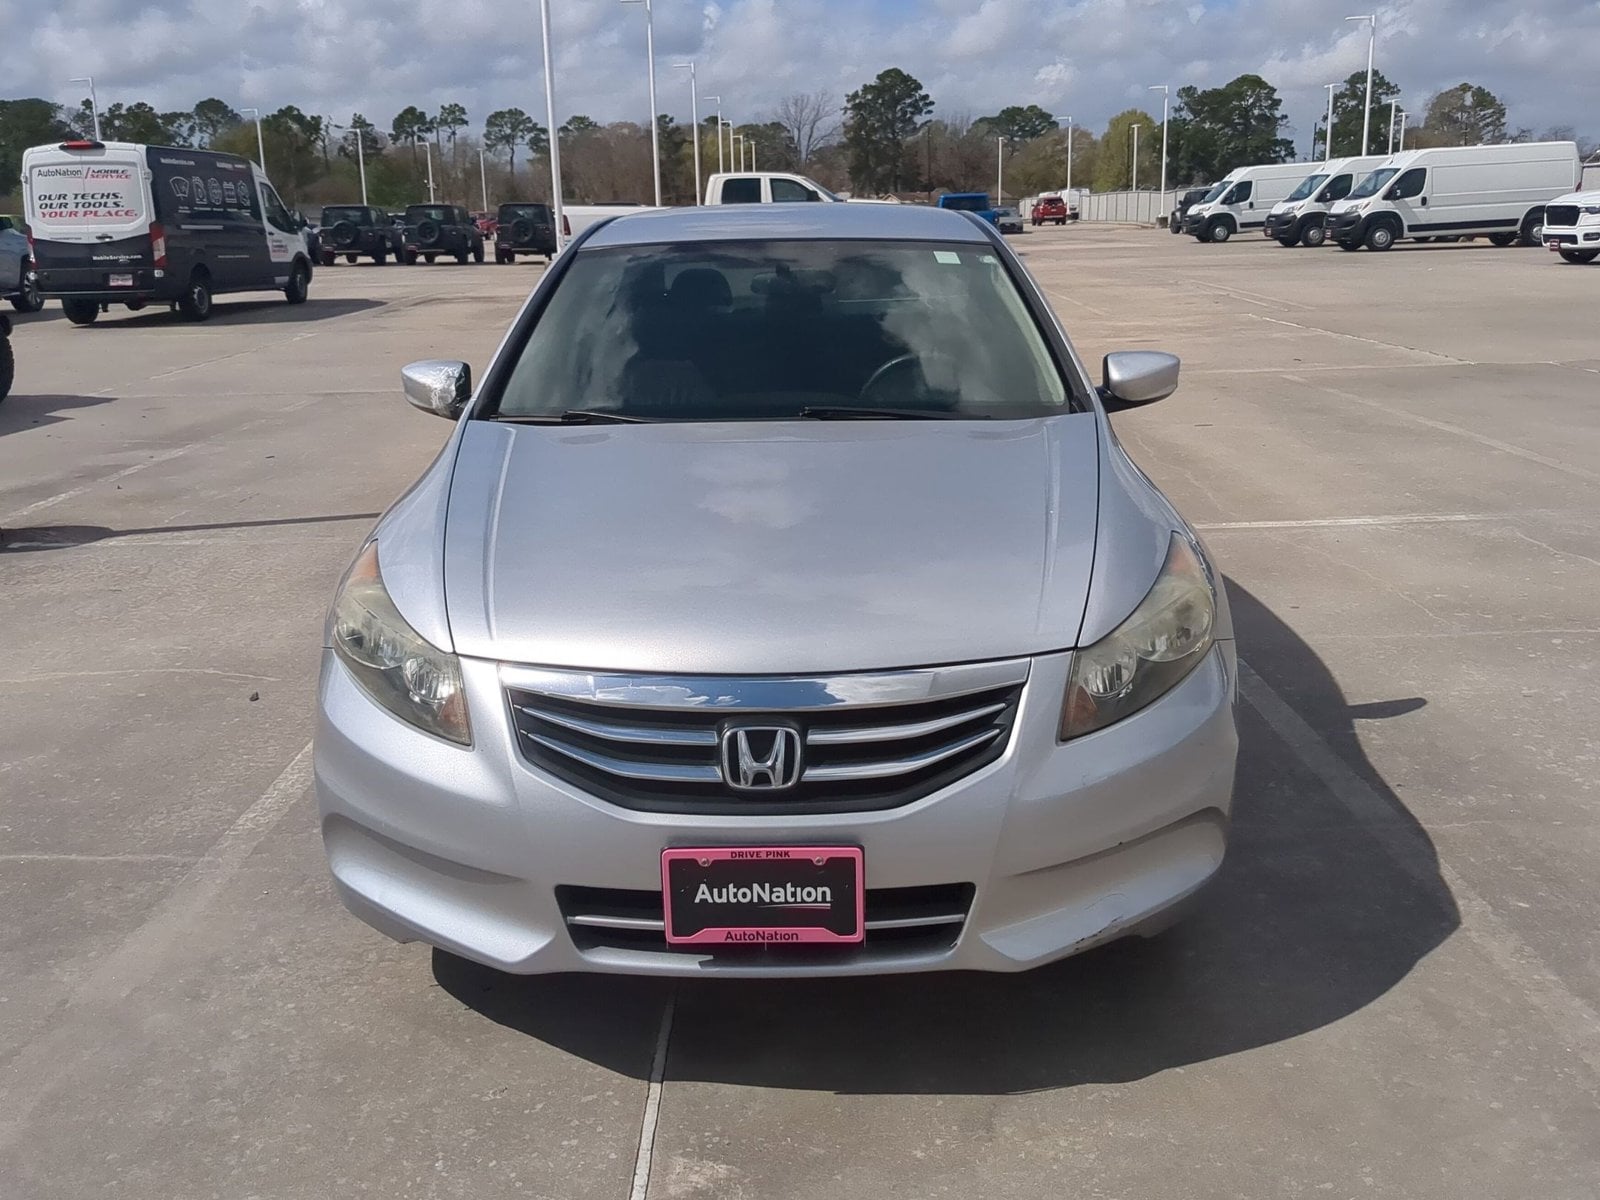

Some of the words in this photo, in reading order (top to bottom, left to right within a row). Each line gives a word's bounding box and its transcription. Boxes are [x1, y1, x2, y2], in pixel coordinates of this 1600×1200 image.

[37, 168, 82, 177] AutoNation
[38, 193, 68, 201] OUR
[73, 192, 123, 200] TECHS.
[39, 202, 69, 210] OUR
[74, 201, 124, 209] TOOLS.
[41, 210, 79, 218] YOUR
[82, 209, 138, 217] PLACE.
[730, 851, 762, 859] DRIVE
[765, 850, 790, 858] PINK
[694, 882, 831, 904] AutoNation
[724, 931, 799, 942] AutoNation
